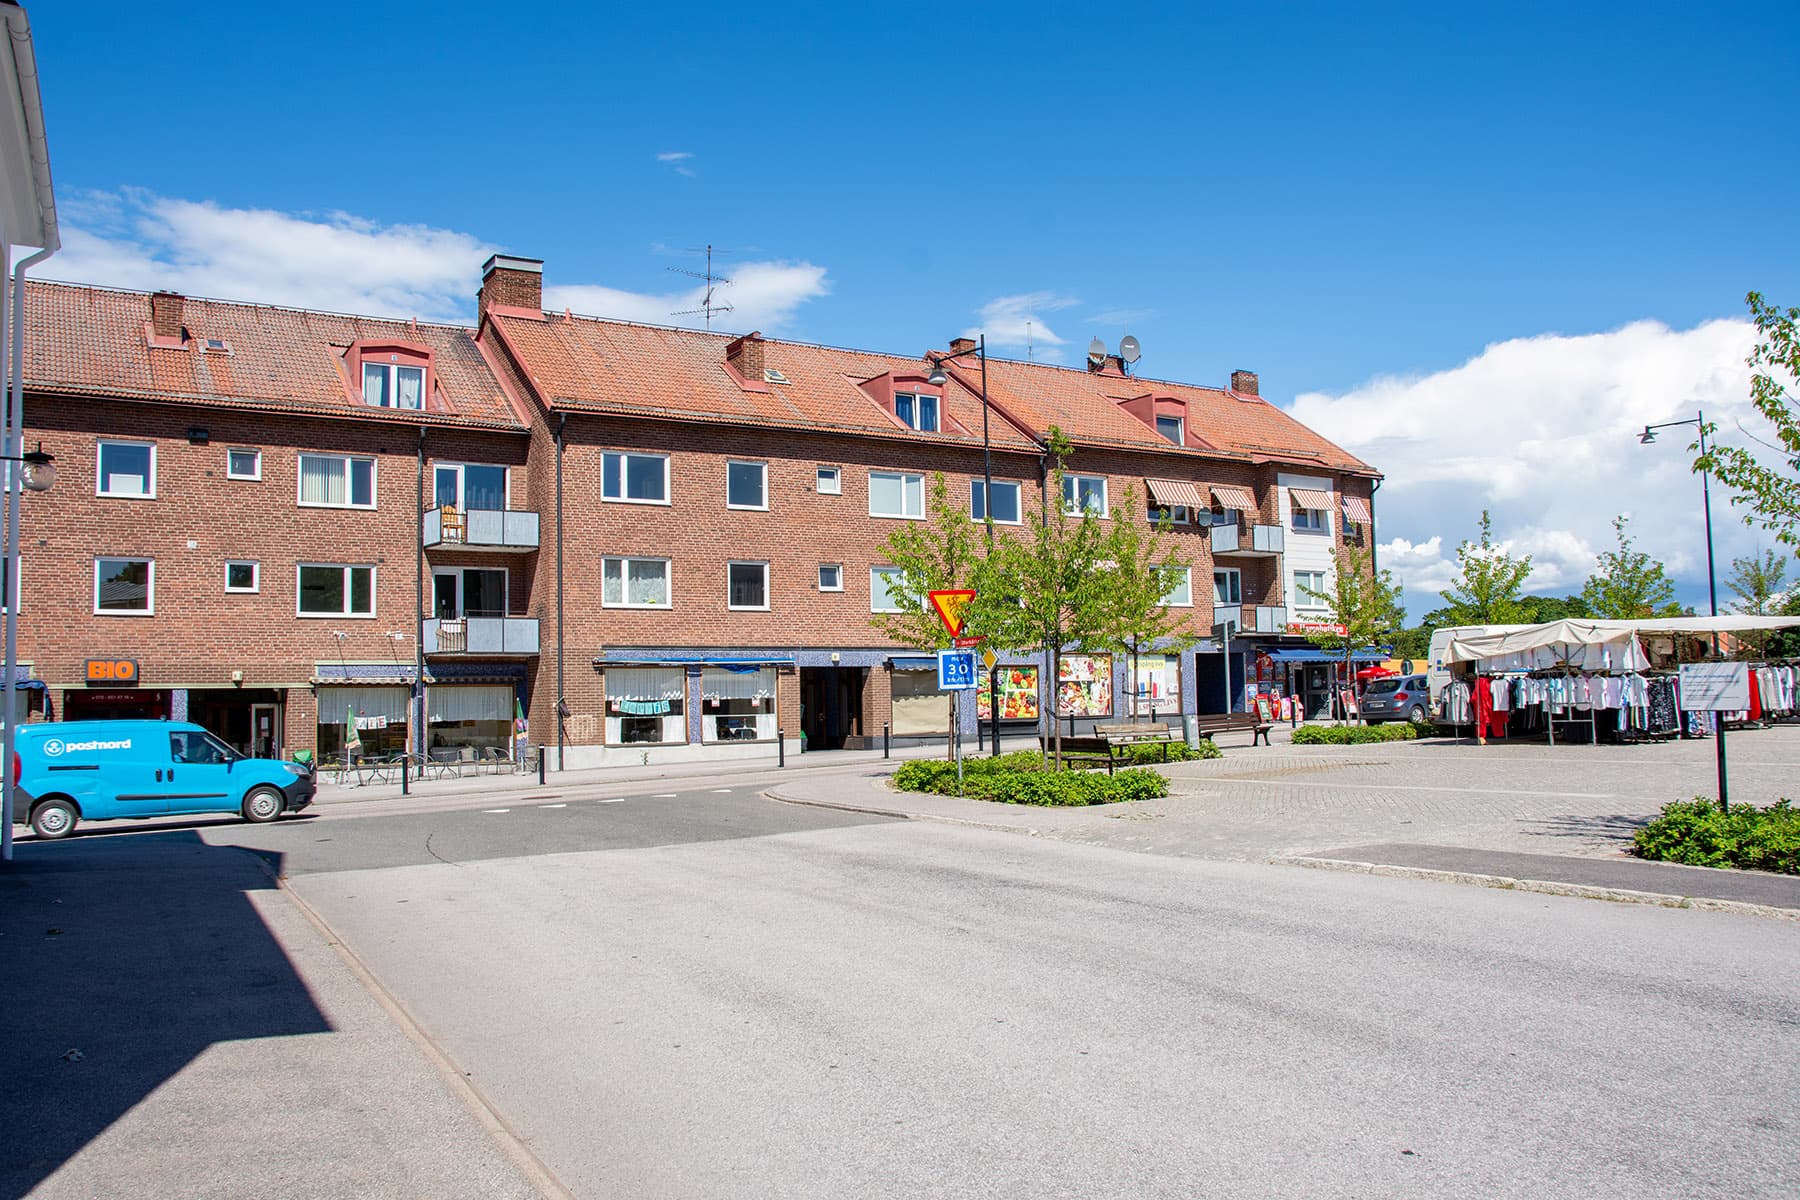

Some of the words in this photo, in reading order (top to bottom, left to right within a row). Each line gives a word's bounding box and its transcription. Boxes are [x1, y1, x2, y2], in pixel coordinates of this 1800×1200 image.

[88, 661, 134, 679] BIO
[948, 664, 968, 675] 30
[66, 739, 131, 752] postnord
